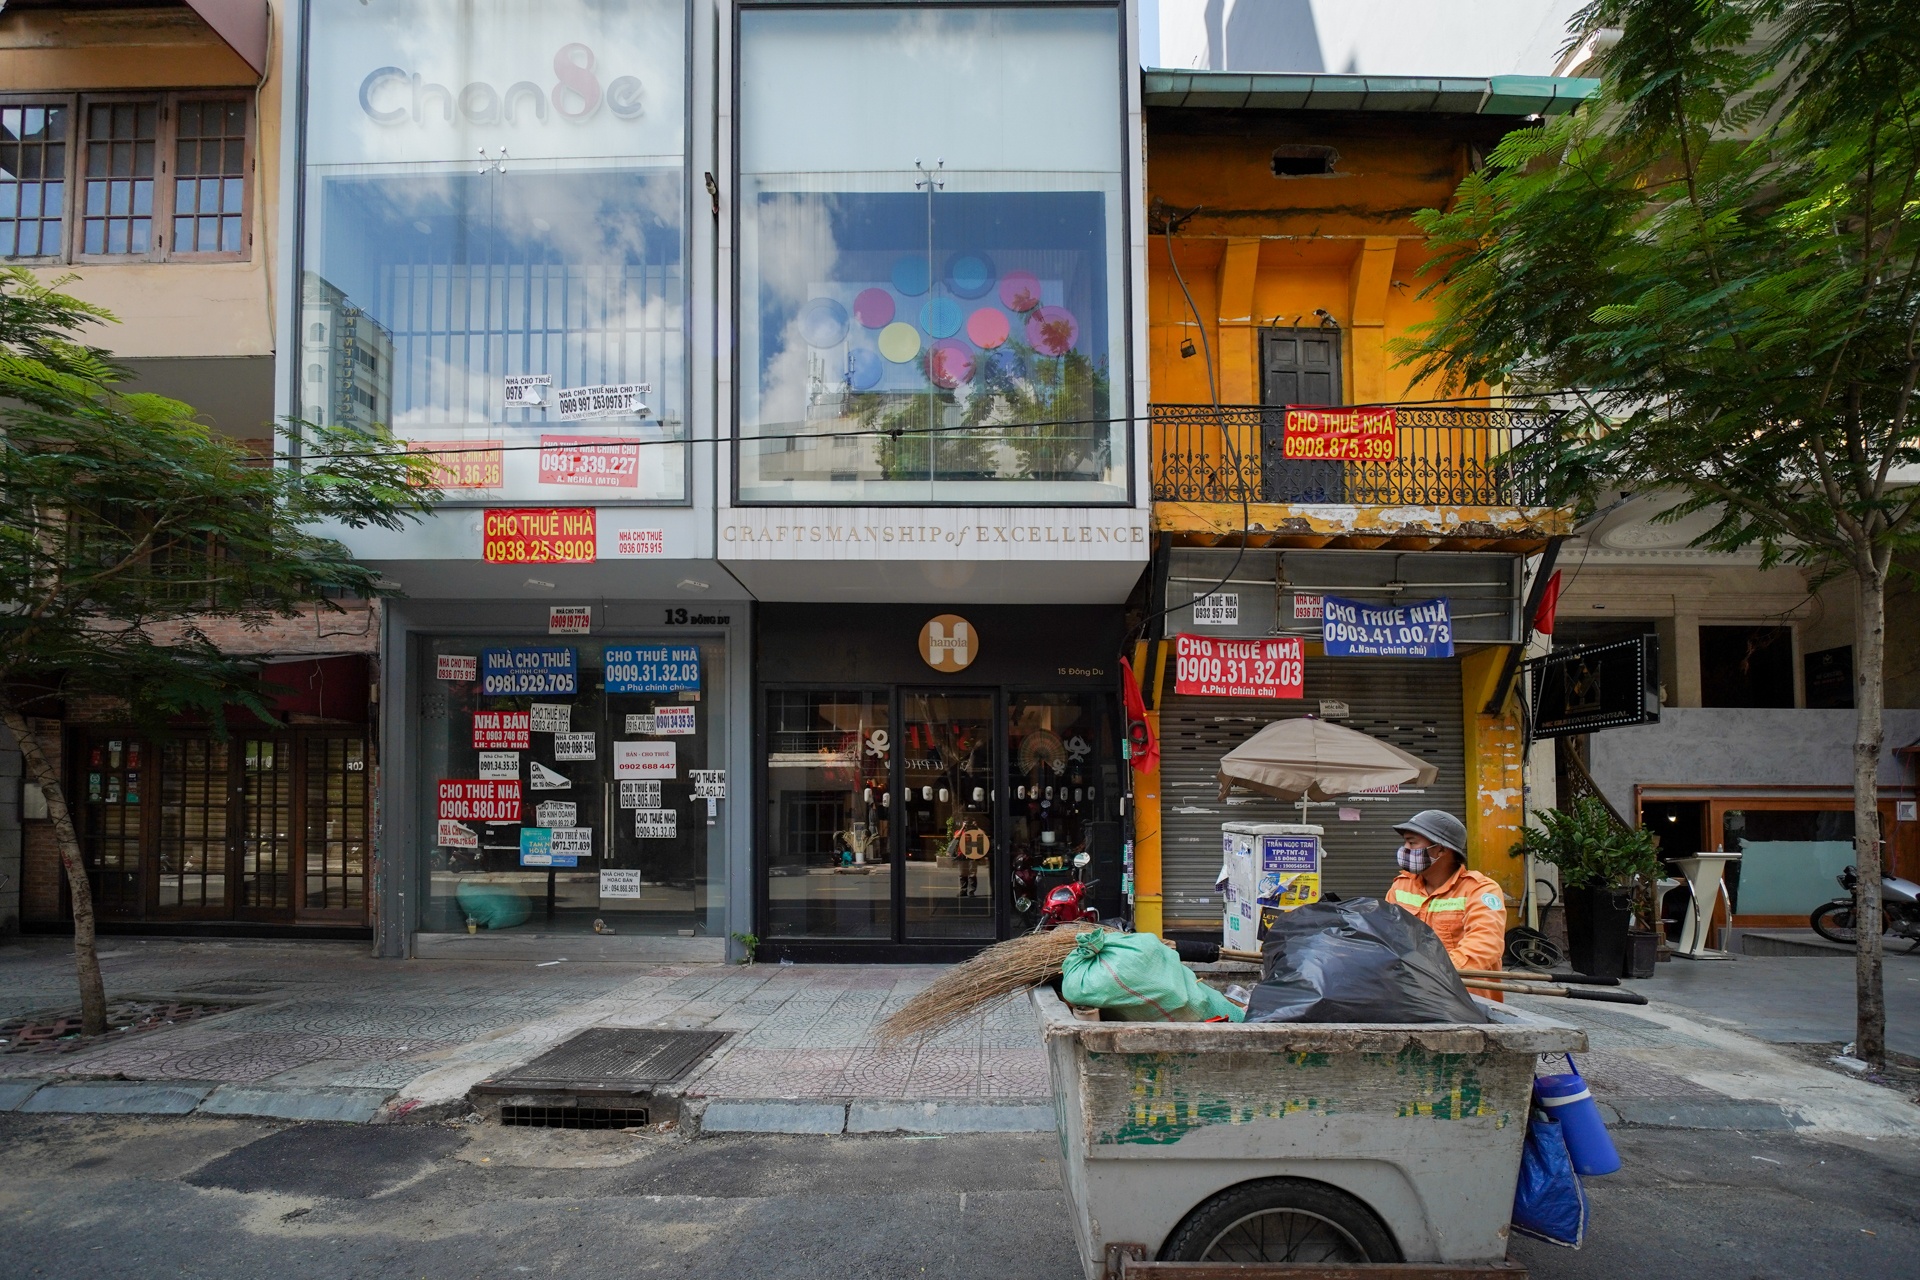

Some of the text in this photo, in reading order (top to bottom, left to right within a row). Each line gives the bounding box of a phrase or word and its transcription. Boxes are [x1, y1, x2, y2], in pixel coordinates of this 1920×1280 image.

[506, 386, 522, 400] 0978
[574, 388, 586, 396] CHO
[560, 400, 577, 413] 0909
[579, 397, 590, 411] 997
[594, 396, 605, 409] 263
[605, 395, 622, 408] 0978
[1287, 409, 1393, 434] CHO THUÊ NHÀ
[1286, 437, 1392, 459] 0908.875.399
[542, 454, 636, 474] 0931.339.227
[596, 477, 619, 486] (MTG)
[487, 510, 593, 536] CHO THUÊ NHÀ
[619, 529, 631, 540] NHÀ
[633, 532, 645, 540] CHO
[723, 526, 1144, 547] CRAFTSMANSHIP of EXCELLENCE
[487, 541, 593, 561] 0938.25.9909
[619, 543, 662, 553] 0936 075 915
[665, 608, 688, 624] 13
[717, 616, 730, 624] DU
[1196, 608, 1236, 618] 0933 957 550
[1296, 608, 1323, 617] 0936 075
[1326, 600, 1447, 624] CHO NHÀ
[551, 615, 566, 627] 0909
[1326, 623, 1449, 644] 0903.41.00.73
[930, 637, 967, 647] hanoia
[1178, 637, 1300, 659] CHO THUÊ NHÀ
[606, 648, 697, 662] CHO THUÊ NHÀ
[1350, 645, 1377, 653] A.Nam
[451, 658, 461, 668] CHO
[489, 648, 570, 668] NHÀ CHO THUÊ
[439, 669, 475, 679] 0936 075 915
[607, 664, 697, 682] 0909.31.32.03
[1069, 668, 1090, 676] Đông
[1178, 657, 1301, 686] 0909.31.32.03
[486, 674, 573, 692] 0981.929.705
[532, 708, 543, 719] CHO
[1587, 711, 1629, 721] CENTRAL
[475, 712, 528, 729] NHÀ BÁN
[657, 716, 670, 728] 0901
[486, 731, 528, 740] 0903 675
[481, 761, 517, 770] 0901.34.35.35
[440, 782, 520, 799] CHO THUÊ NHÀ
[622, 784, 633, 792] CHO
[440, 801, 519, 818] 0906.980.017
[637, 813, 648, 824] CHO
